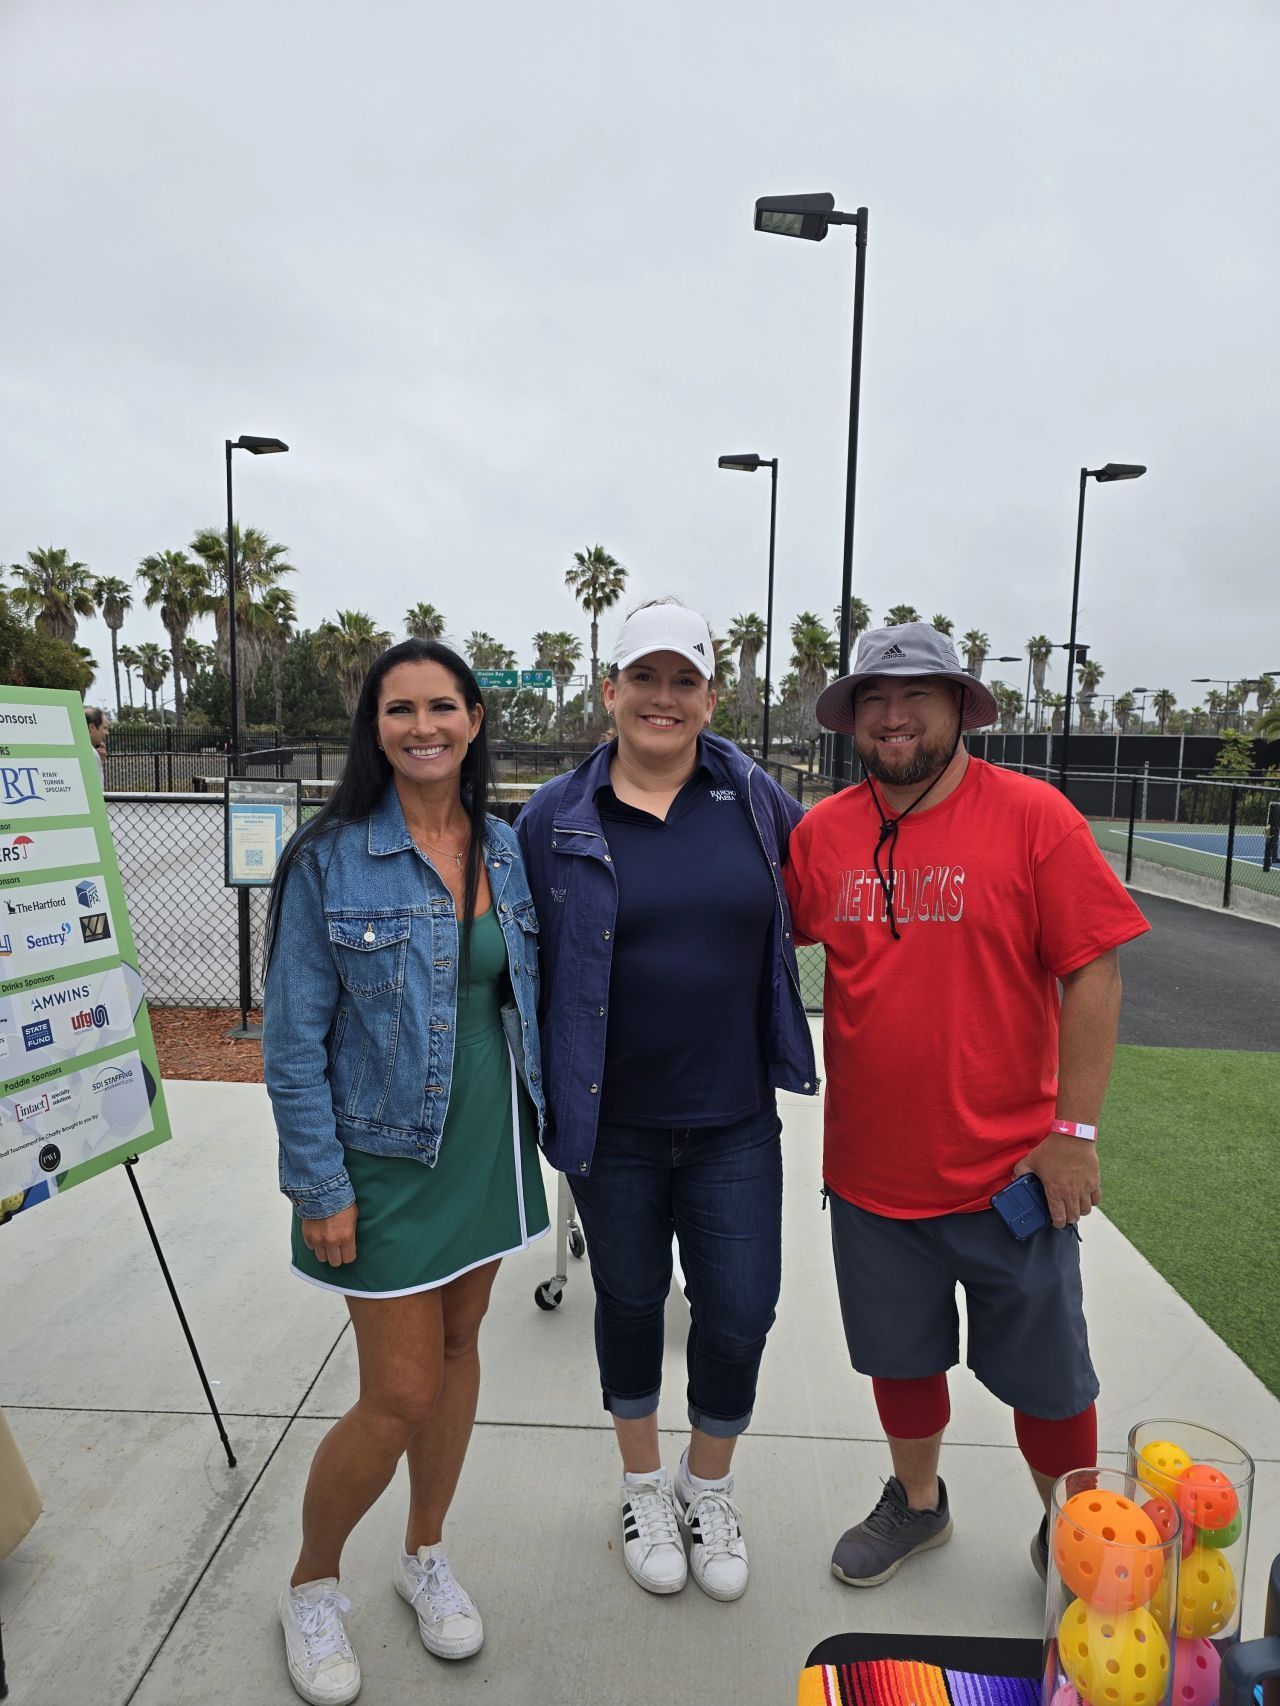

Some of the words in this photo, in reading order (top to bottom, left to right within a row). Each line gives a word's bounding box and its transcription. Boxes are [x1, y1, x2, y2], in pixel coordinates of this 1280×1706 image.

[709, 789, 737, 798] RANCHO
[16, 903, 33, 914] The
[32, 896, 66, 911] Hartford
[26, 932, 66, 949] Sentry
[1, 981, 24, 993] Drinks
[24, 974, 55, 988] Sponsors
[31, 985, 90, 1012] AMWINS
[25, 1023, 48, 1035] STATE
[71, 1010, 93, 1031] ufg
[27, 1035, 51, 1047] FUND
[4, 1077, 31, 1092] Paddle
[31, 1067, 62, 1083] Sponsors
[51, 1089, 70, 1100] specialty
[52, 1095, 72, 1106] solutions
[10, 1137, 38, 1154] Tournament
[45, 1129, 61, 1139] Charity
[61, 1121, 78, 1133] Brought
